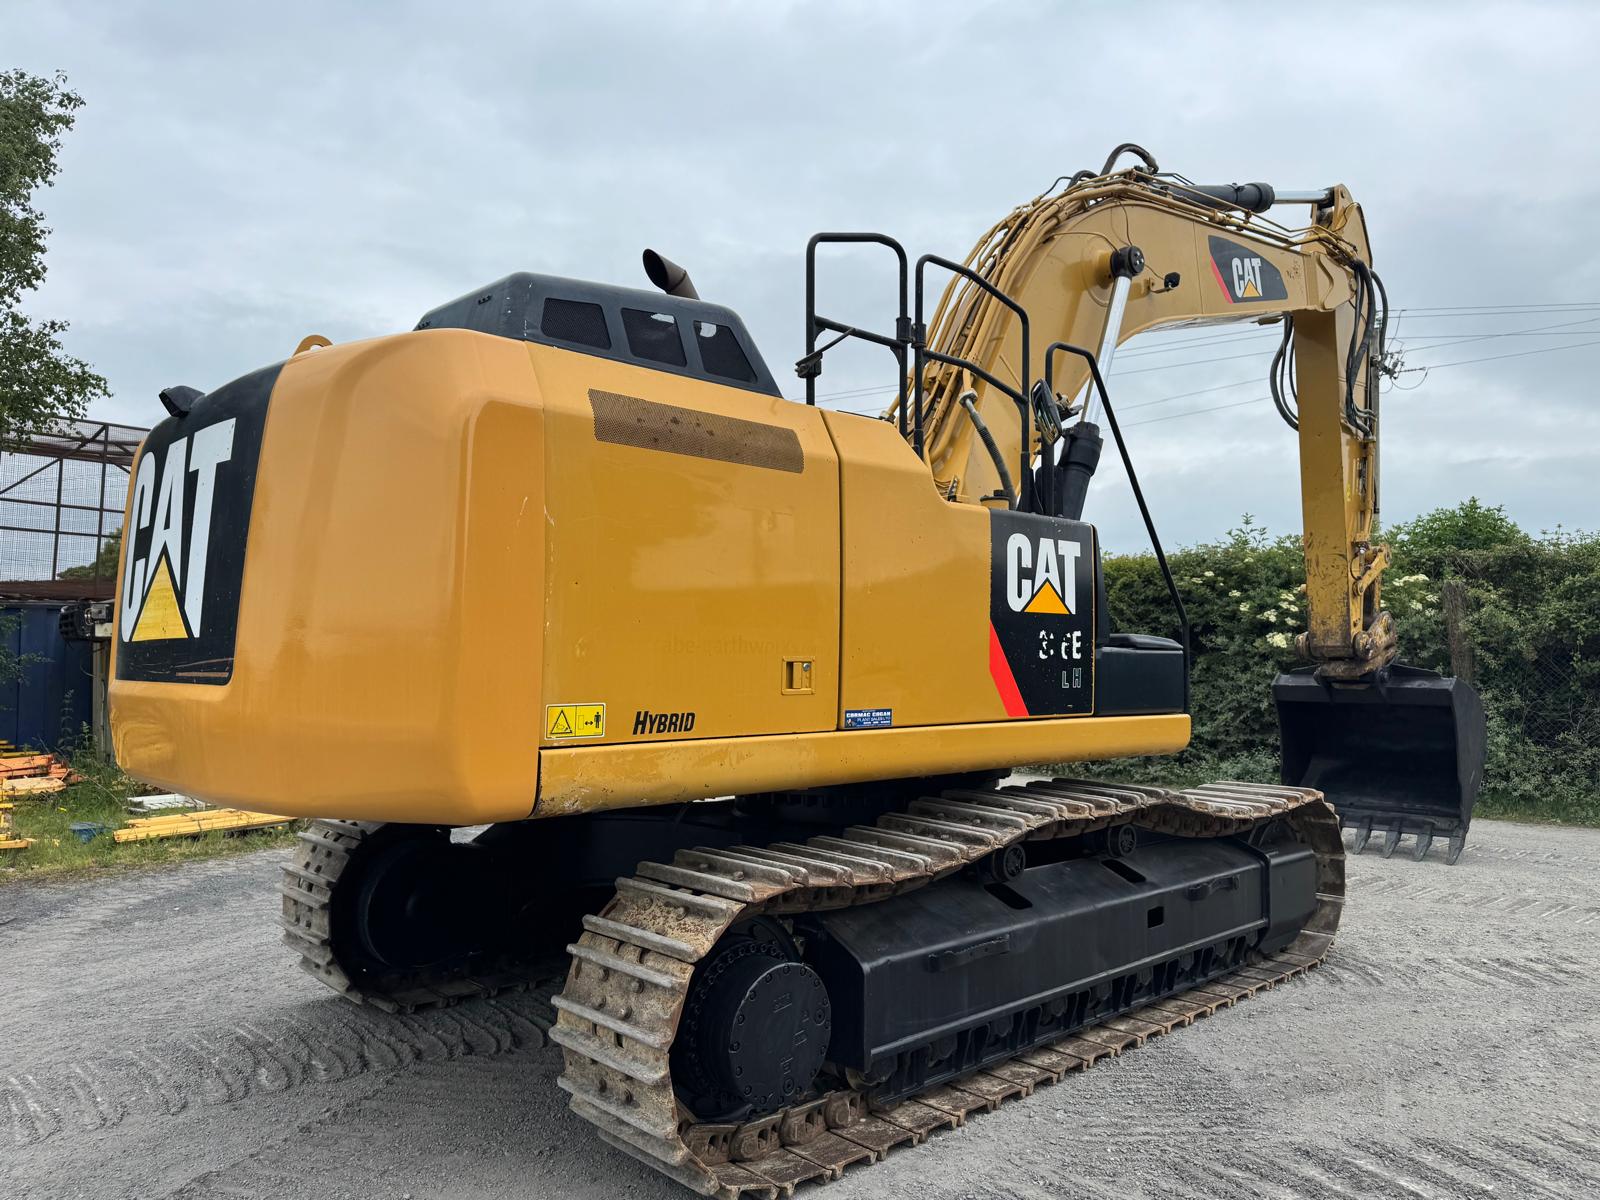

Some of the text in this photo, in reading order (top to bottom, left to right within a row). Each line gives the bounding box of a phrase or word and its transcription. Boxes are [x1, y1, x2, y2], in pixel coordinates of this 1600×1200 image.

[1231, 257, 1263, 298] CAT
[122, 417, 237, 643] CAT
[1006, 532, 1081, 615] CAT
[632, 710, 696, 735] HYBRID
